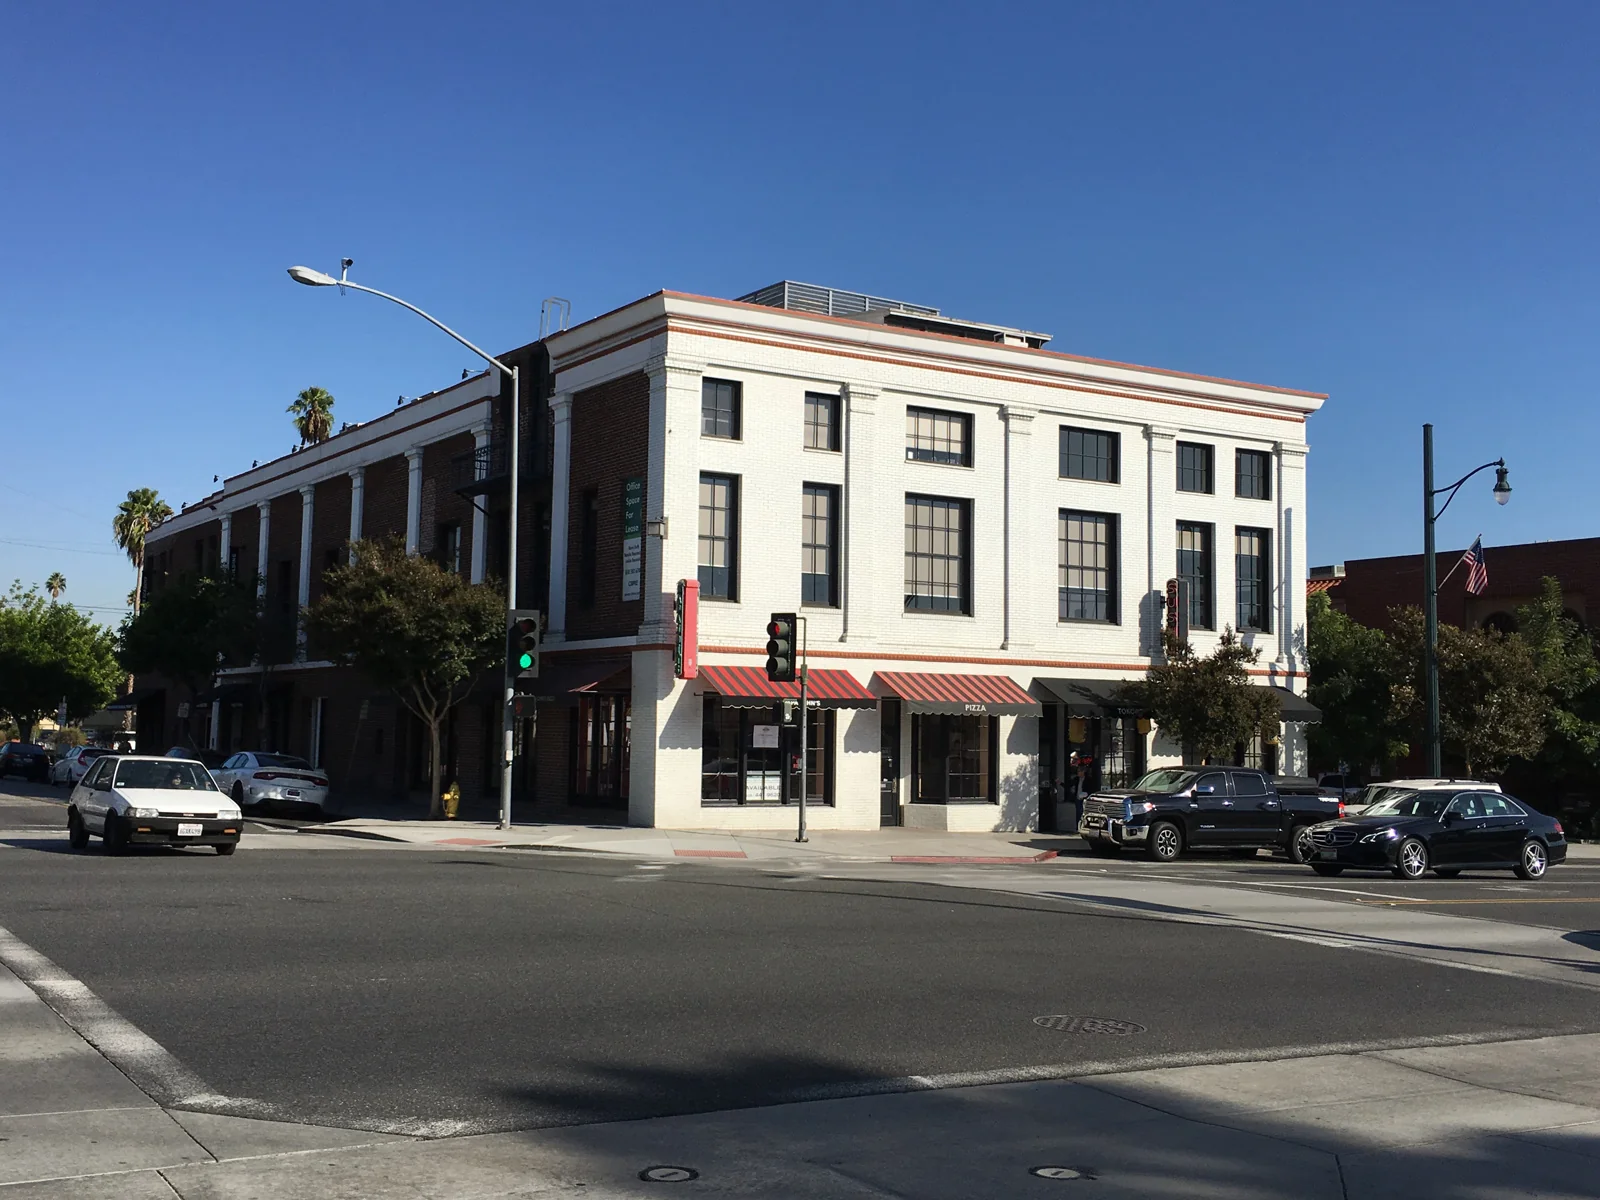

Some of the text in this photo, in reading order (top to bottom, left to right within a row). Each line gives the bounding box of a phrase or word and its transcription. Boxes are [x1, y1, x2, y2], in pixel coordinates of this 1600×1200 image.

[626, 481, 641, 491] Office
[625, 497, 640, 506] Space
[625, 511, 634, 519] For
[625, 525, 639, 533] Lease
[965, 704, 987, 712] PIZZA
